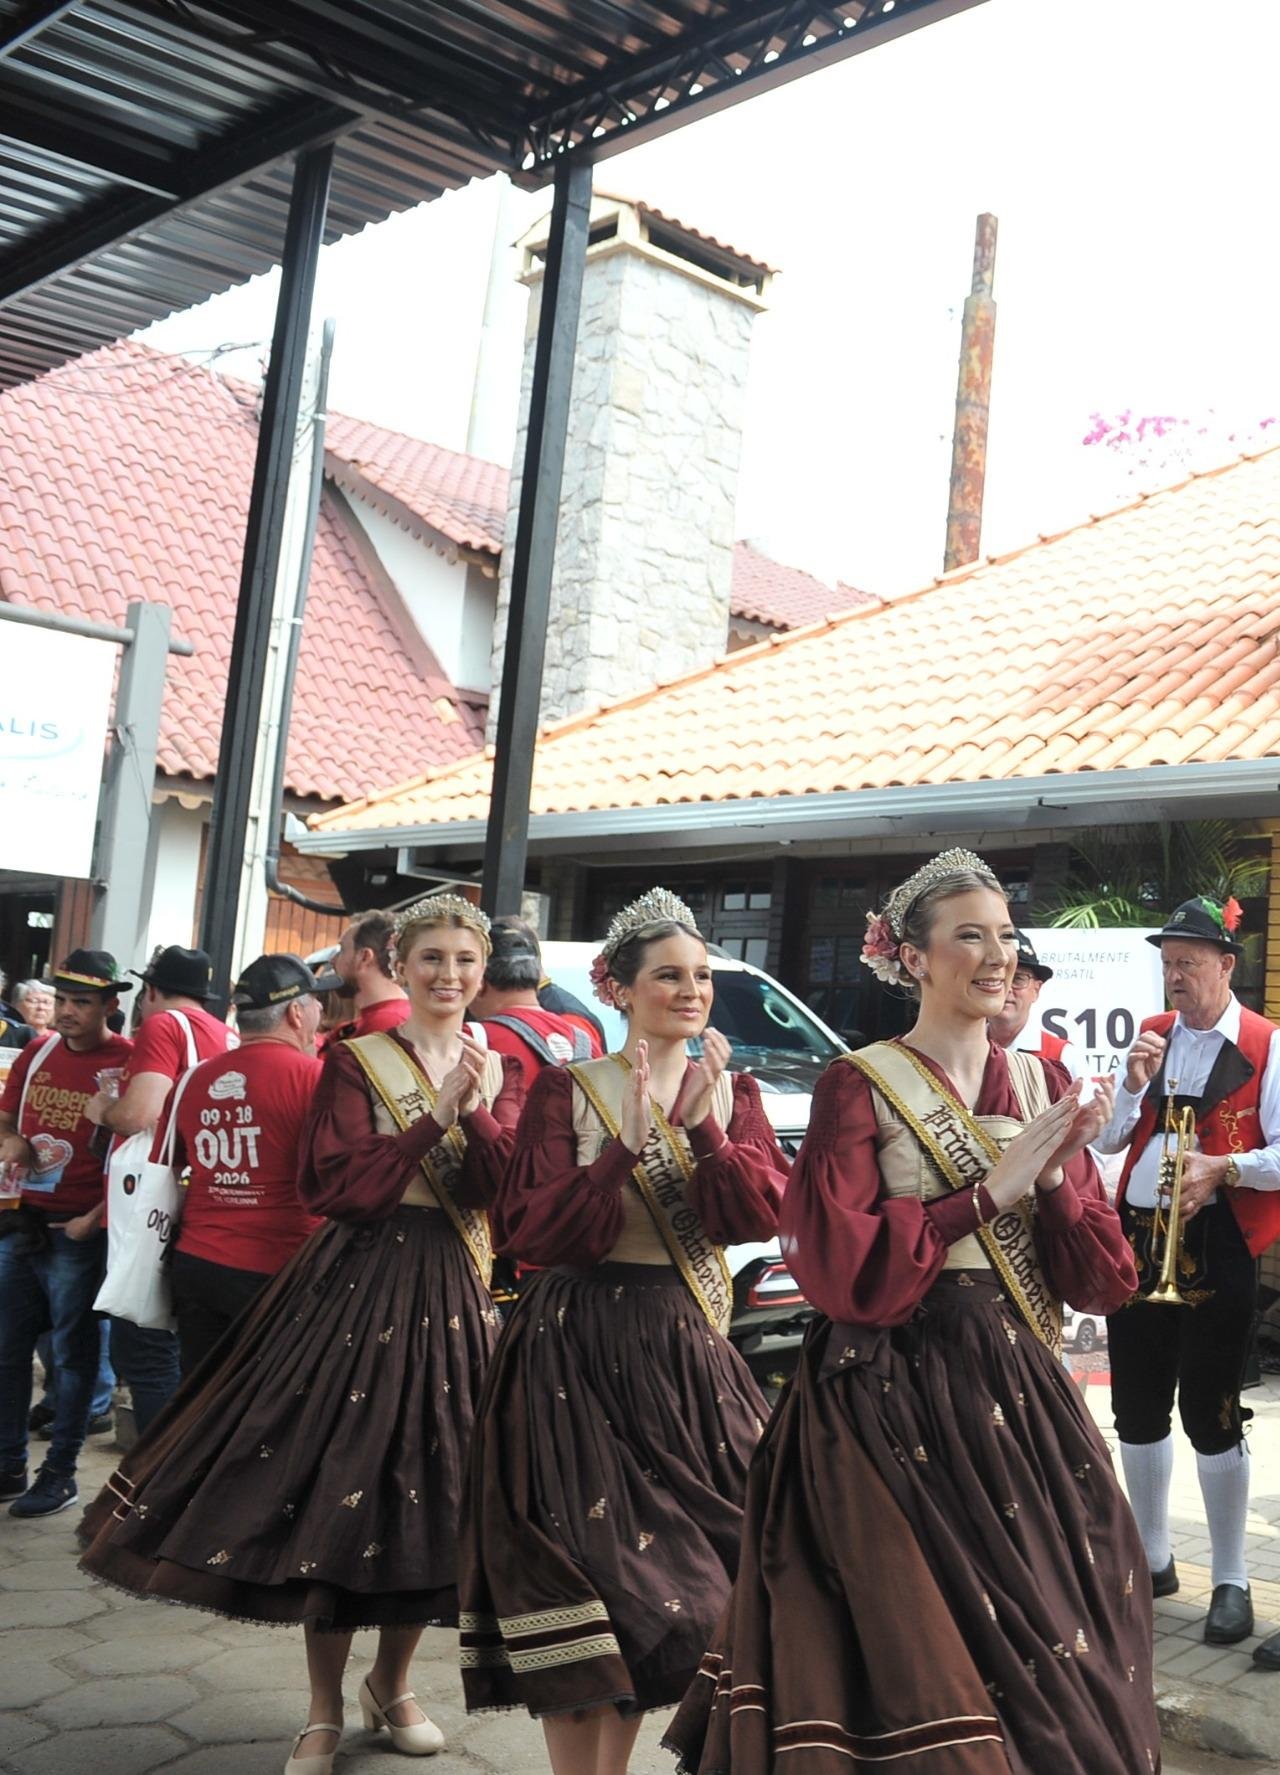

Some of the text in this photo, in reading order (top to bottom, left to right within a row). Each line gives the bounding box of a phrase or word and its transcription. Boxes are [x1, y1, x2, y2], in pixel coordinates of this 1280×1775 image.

[1041, 951, 1131, 963] BRUTALMENTE
[1056, 968, 1095, 980] RSATIL
[1041, 1007, 1135, 1050] S10
[200, 1104, 253, 1126] 09 18
[194, 1126, 262, 1169] OUT
